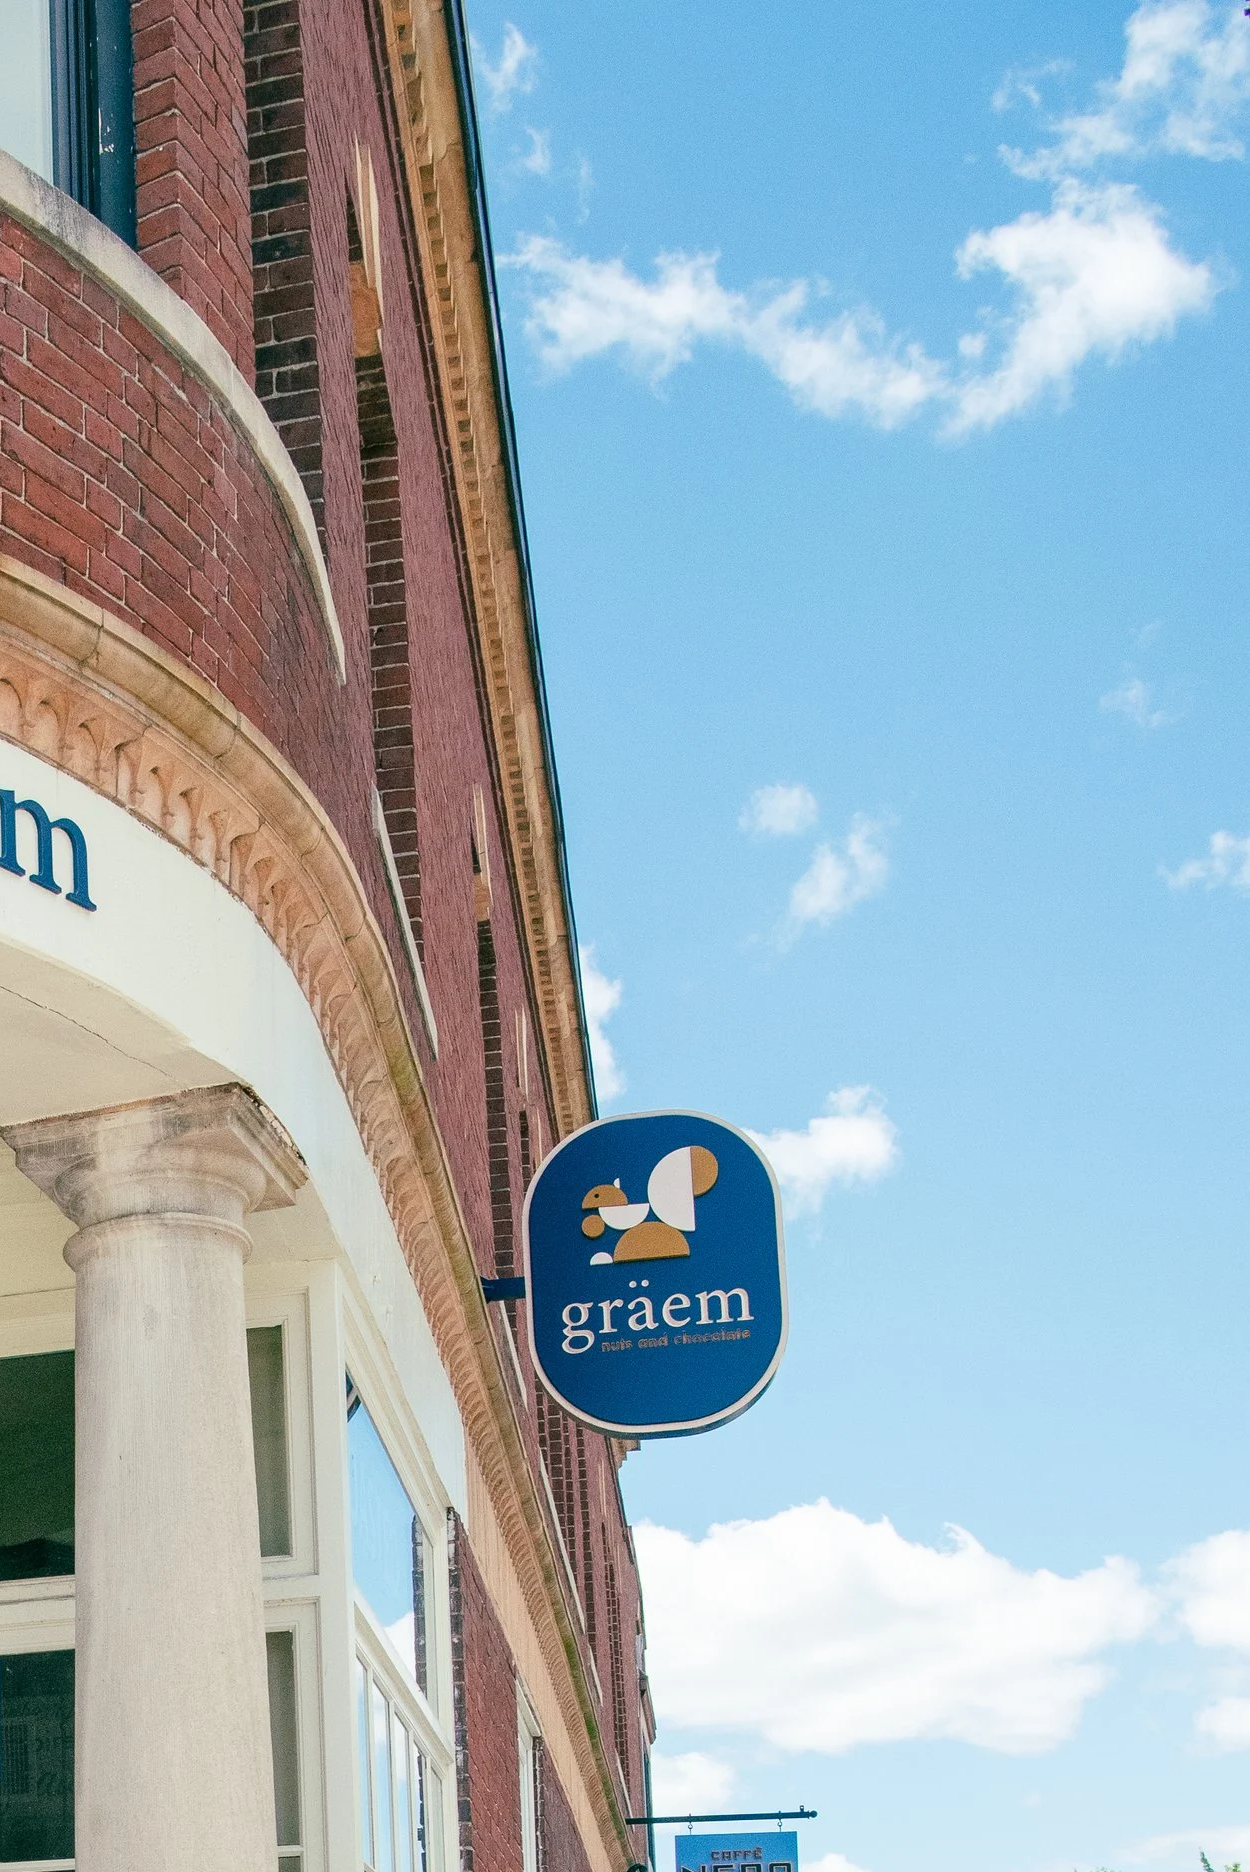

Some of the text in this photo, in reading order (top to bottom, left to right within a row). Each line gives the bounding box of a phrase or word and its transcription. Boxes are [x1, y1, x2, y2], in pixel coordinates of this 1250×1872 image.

[561, 1279, 754, 1355] gräem
[601, 1327, 751, 1352] nuts and chocolate
